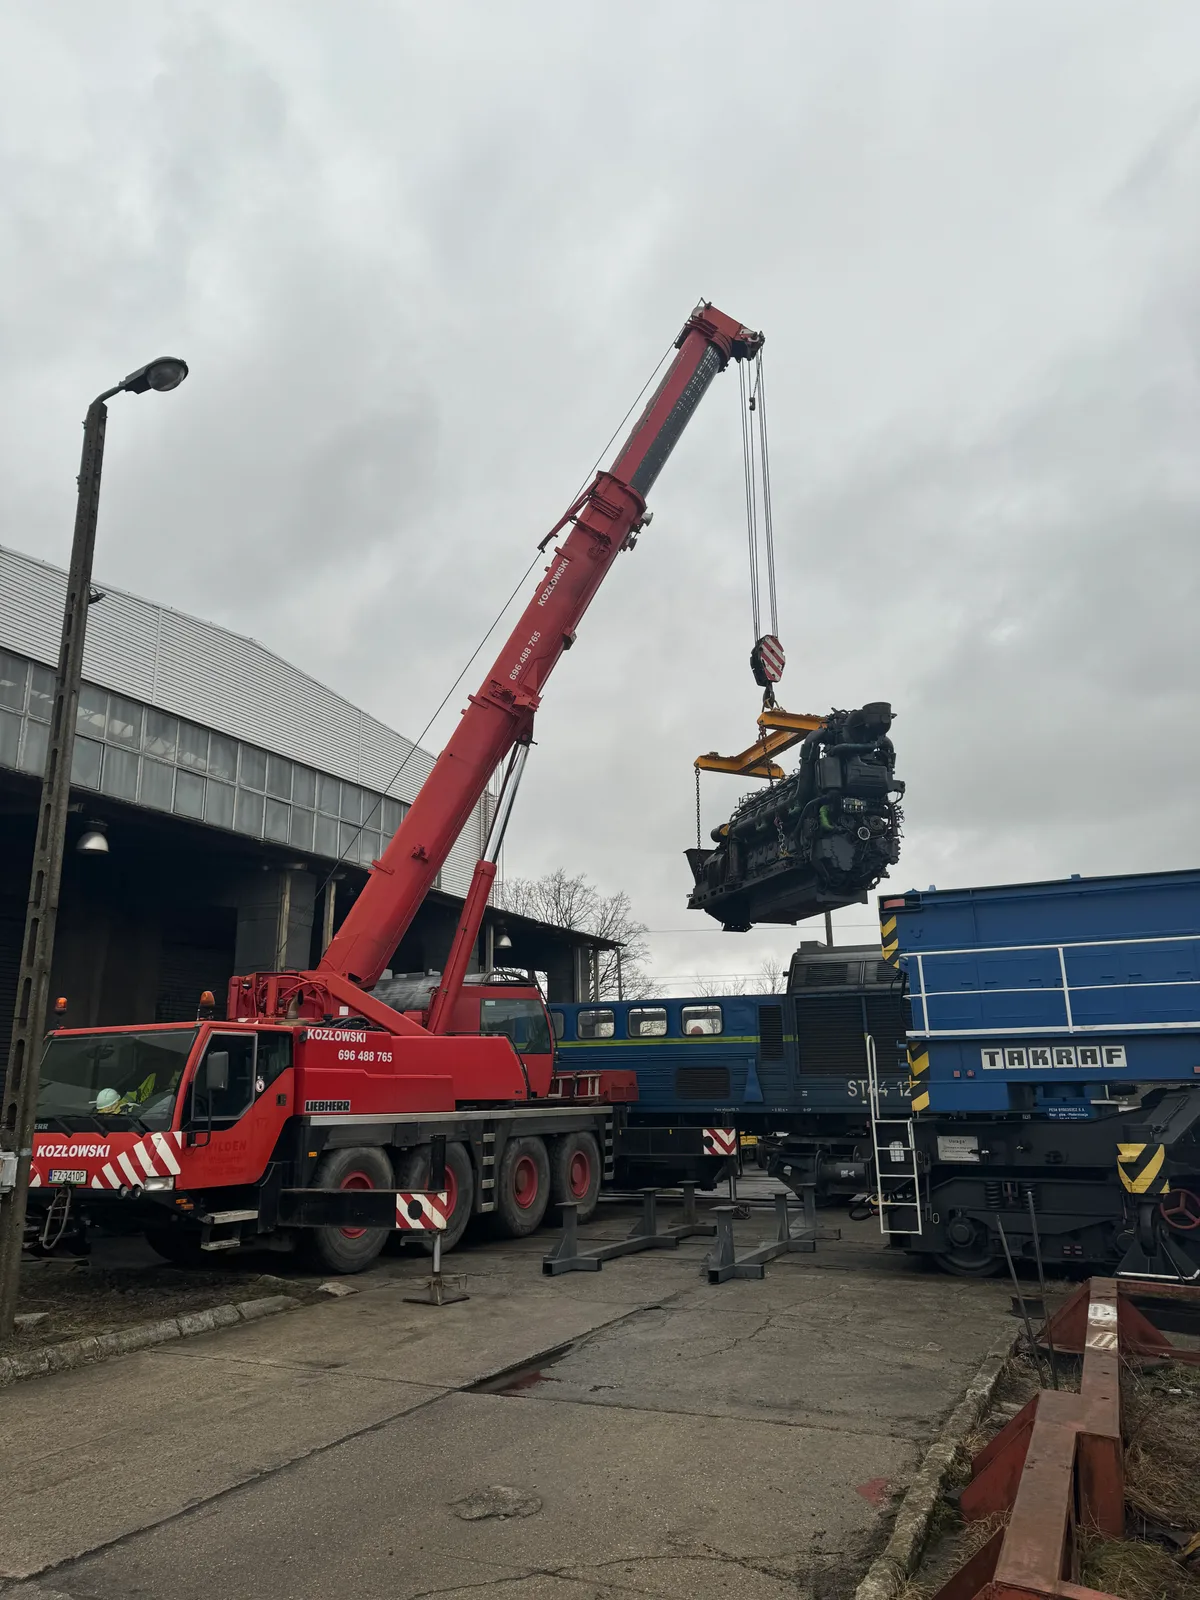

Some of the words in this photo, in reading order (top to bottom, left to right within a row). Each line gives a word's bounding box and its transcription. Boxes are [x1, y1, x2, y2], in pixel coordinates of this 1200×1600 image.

[537, 558, 570, 607] KOZŁOWSKI
[509, 663, 522, 681] 696
[519, 647, 532, 664] 488
[527, 630, 541, 647] 765
[307, 1028, 367, 1043] KOZŁOWSKI
[338, 1049, 356, 1061] 696
[357, 1050, 375, 1062] 488
[376, 1051, 393, 1063] 765
[983, 1048, 1123, 1067] TAKRAF
[305, 1100, 350, 1112] LIEBHERR
[36, 1144, 111, 1158] KOZŁOWSKI
